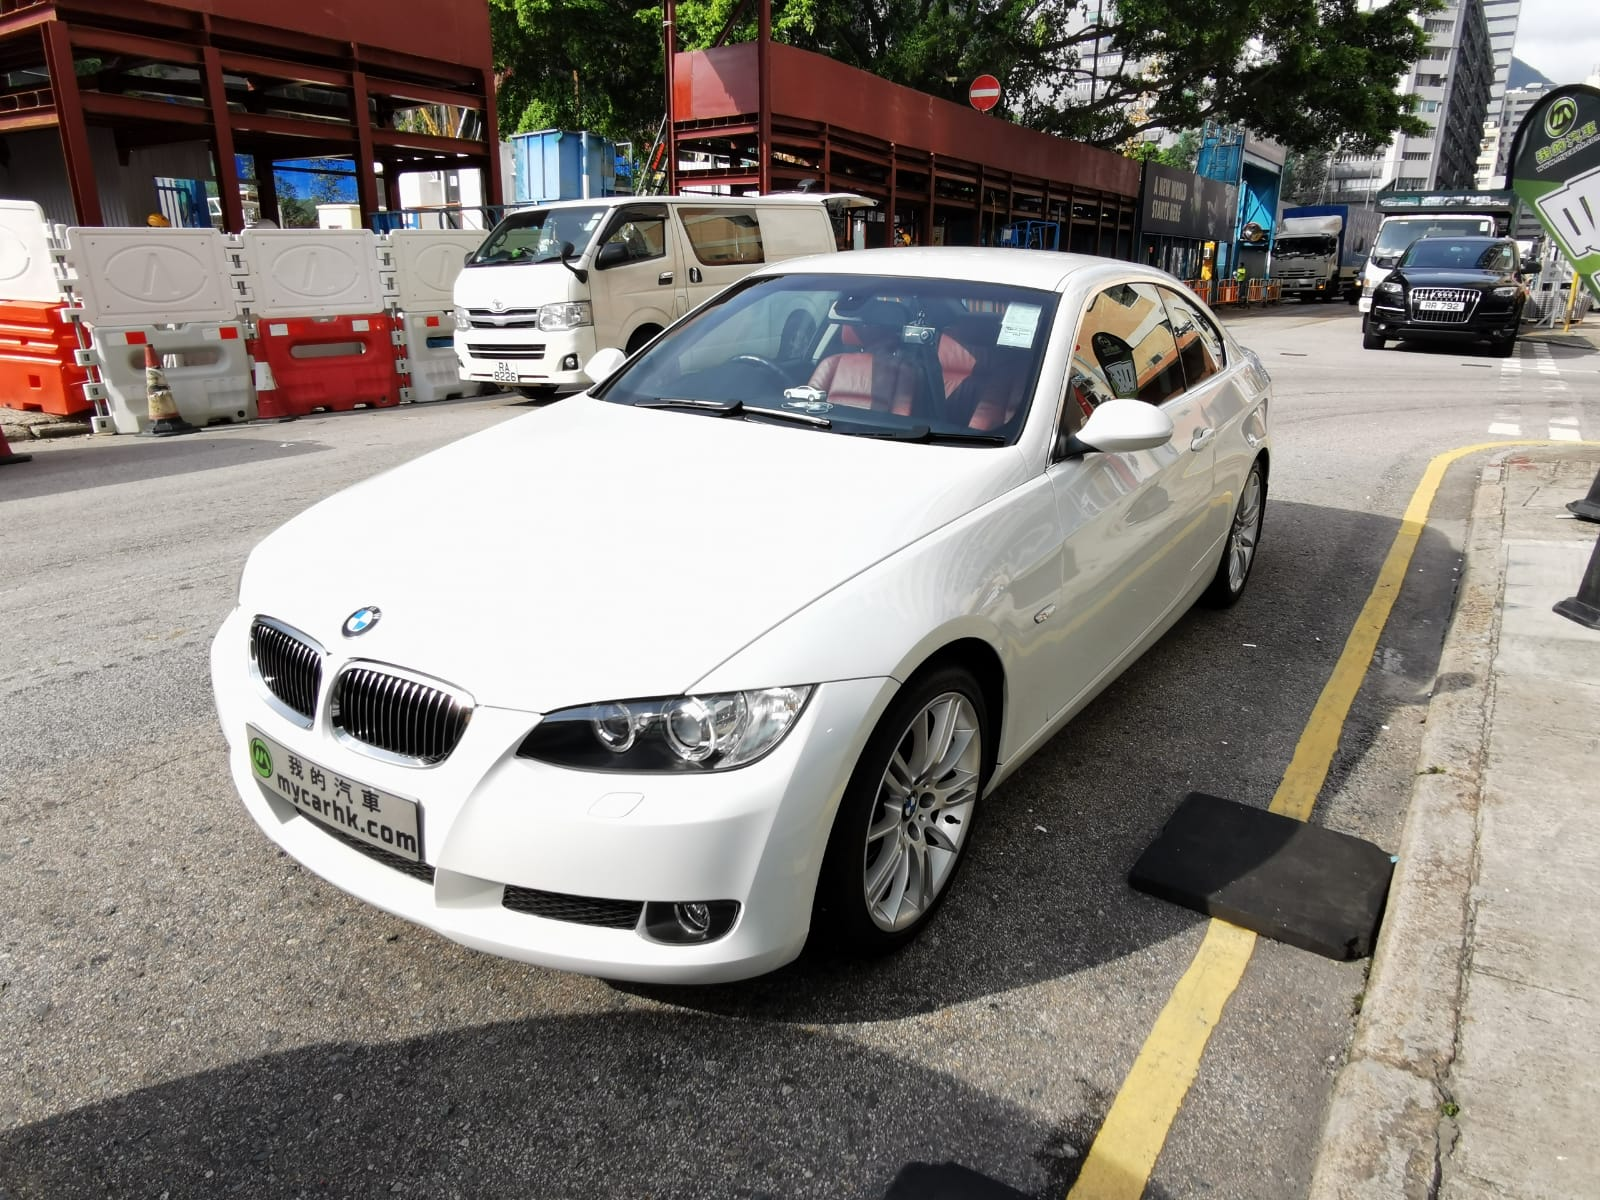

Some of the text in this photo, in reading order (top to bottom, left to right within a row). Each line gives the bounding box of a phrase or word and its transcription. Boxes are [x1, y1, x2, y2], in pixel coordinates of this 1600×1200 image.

[1159, 177, 1171, 197] NEW
[1440, 302, 1459, 310] 792
[498, 362, 509, 371] RA
[288, 754, 381, 813] 我的汽車
[277, 773, 417, 853] mycarhk.com
